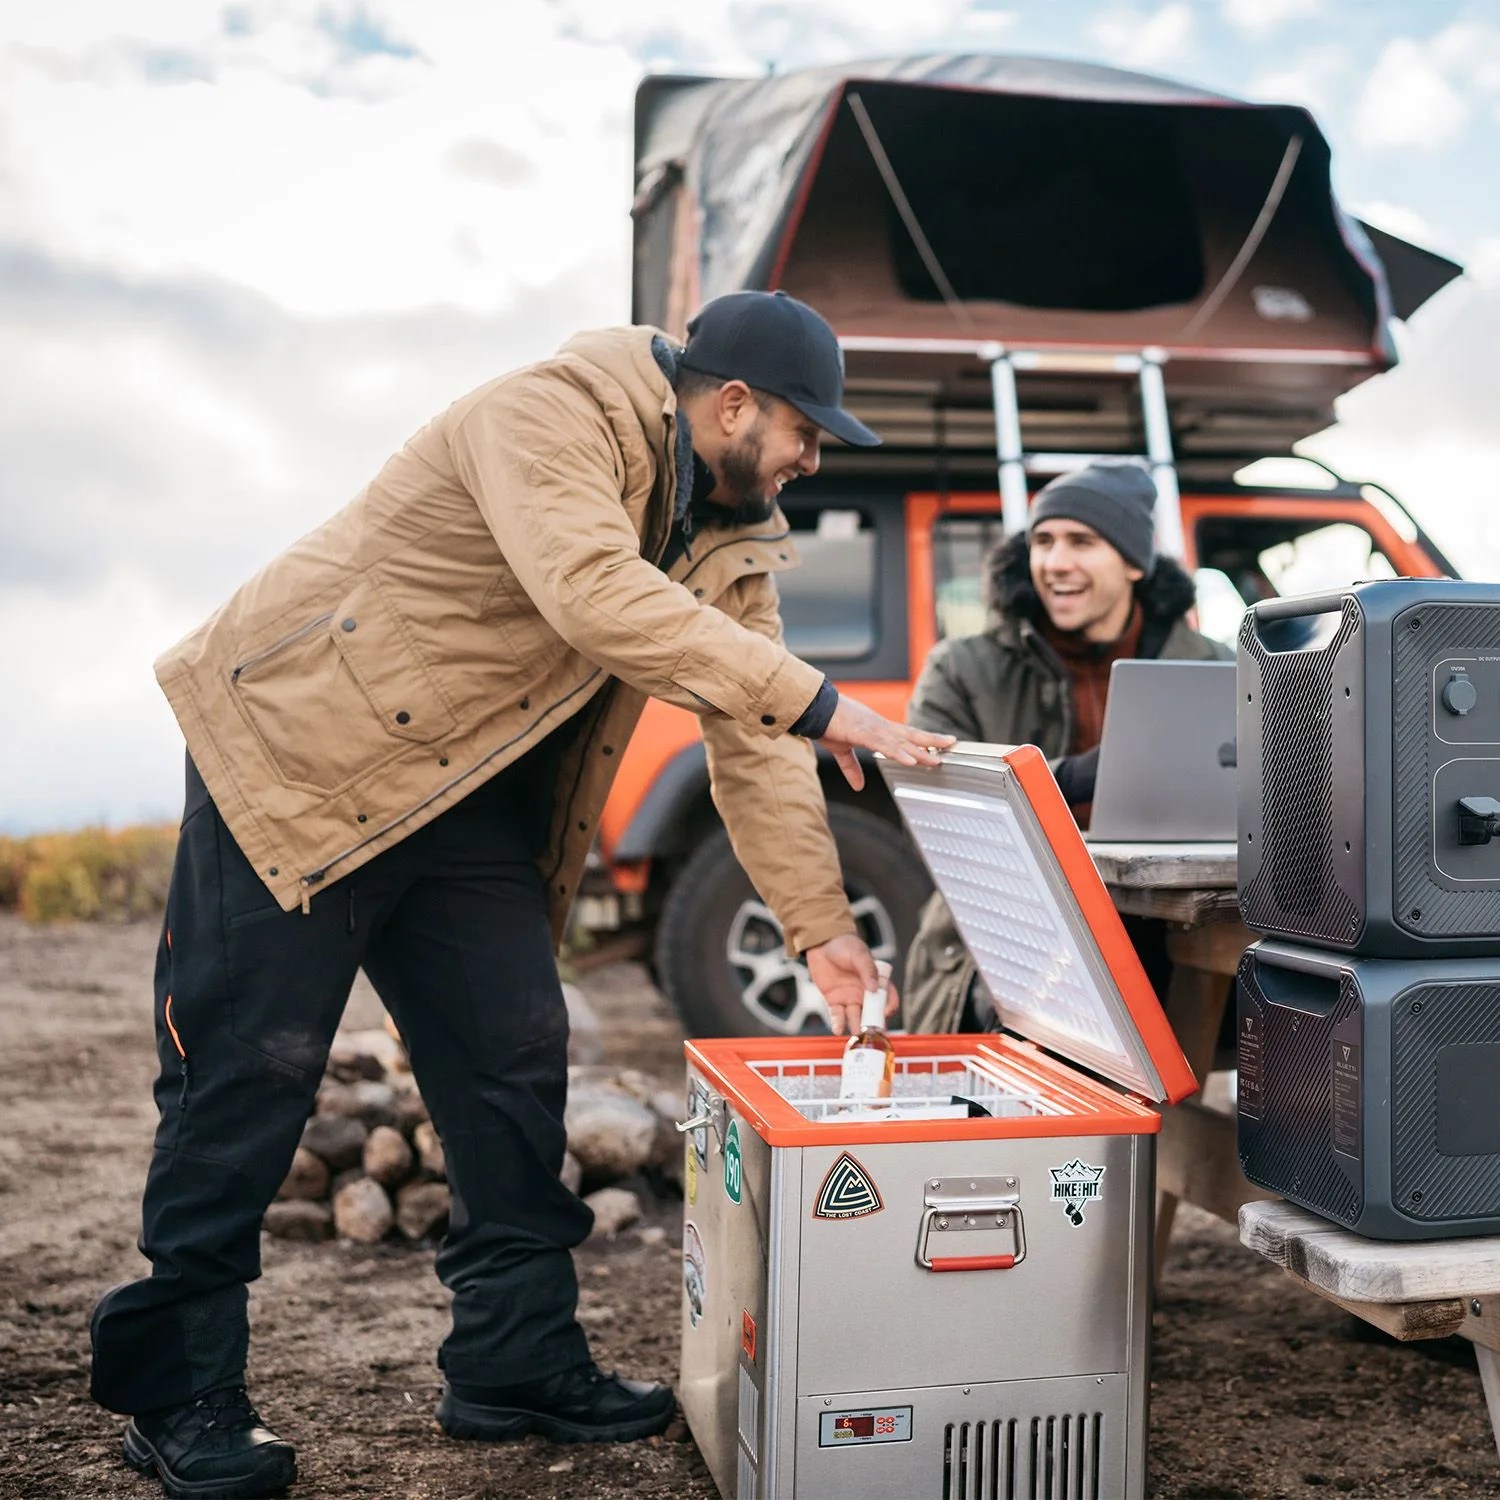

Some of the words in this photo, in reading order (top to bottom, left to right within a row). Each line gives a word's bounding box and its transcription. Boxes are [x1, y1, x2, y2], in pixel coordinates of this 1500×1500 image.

[726, 1151, 740, 1193] 190
[1054, 1183, 1077, 1197] HIKE
[1082, 1183, 1098, 1196] HIT
[854, 1207, 872, 1216] COAST
